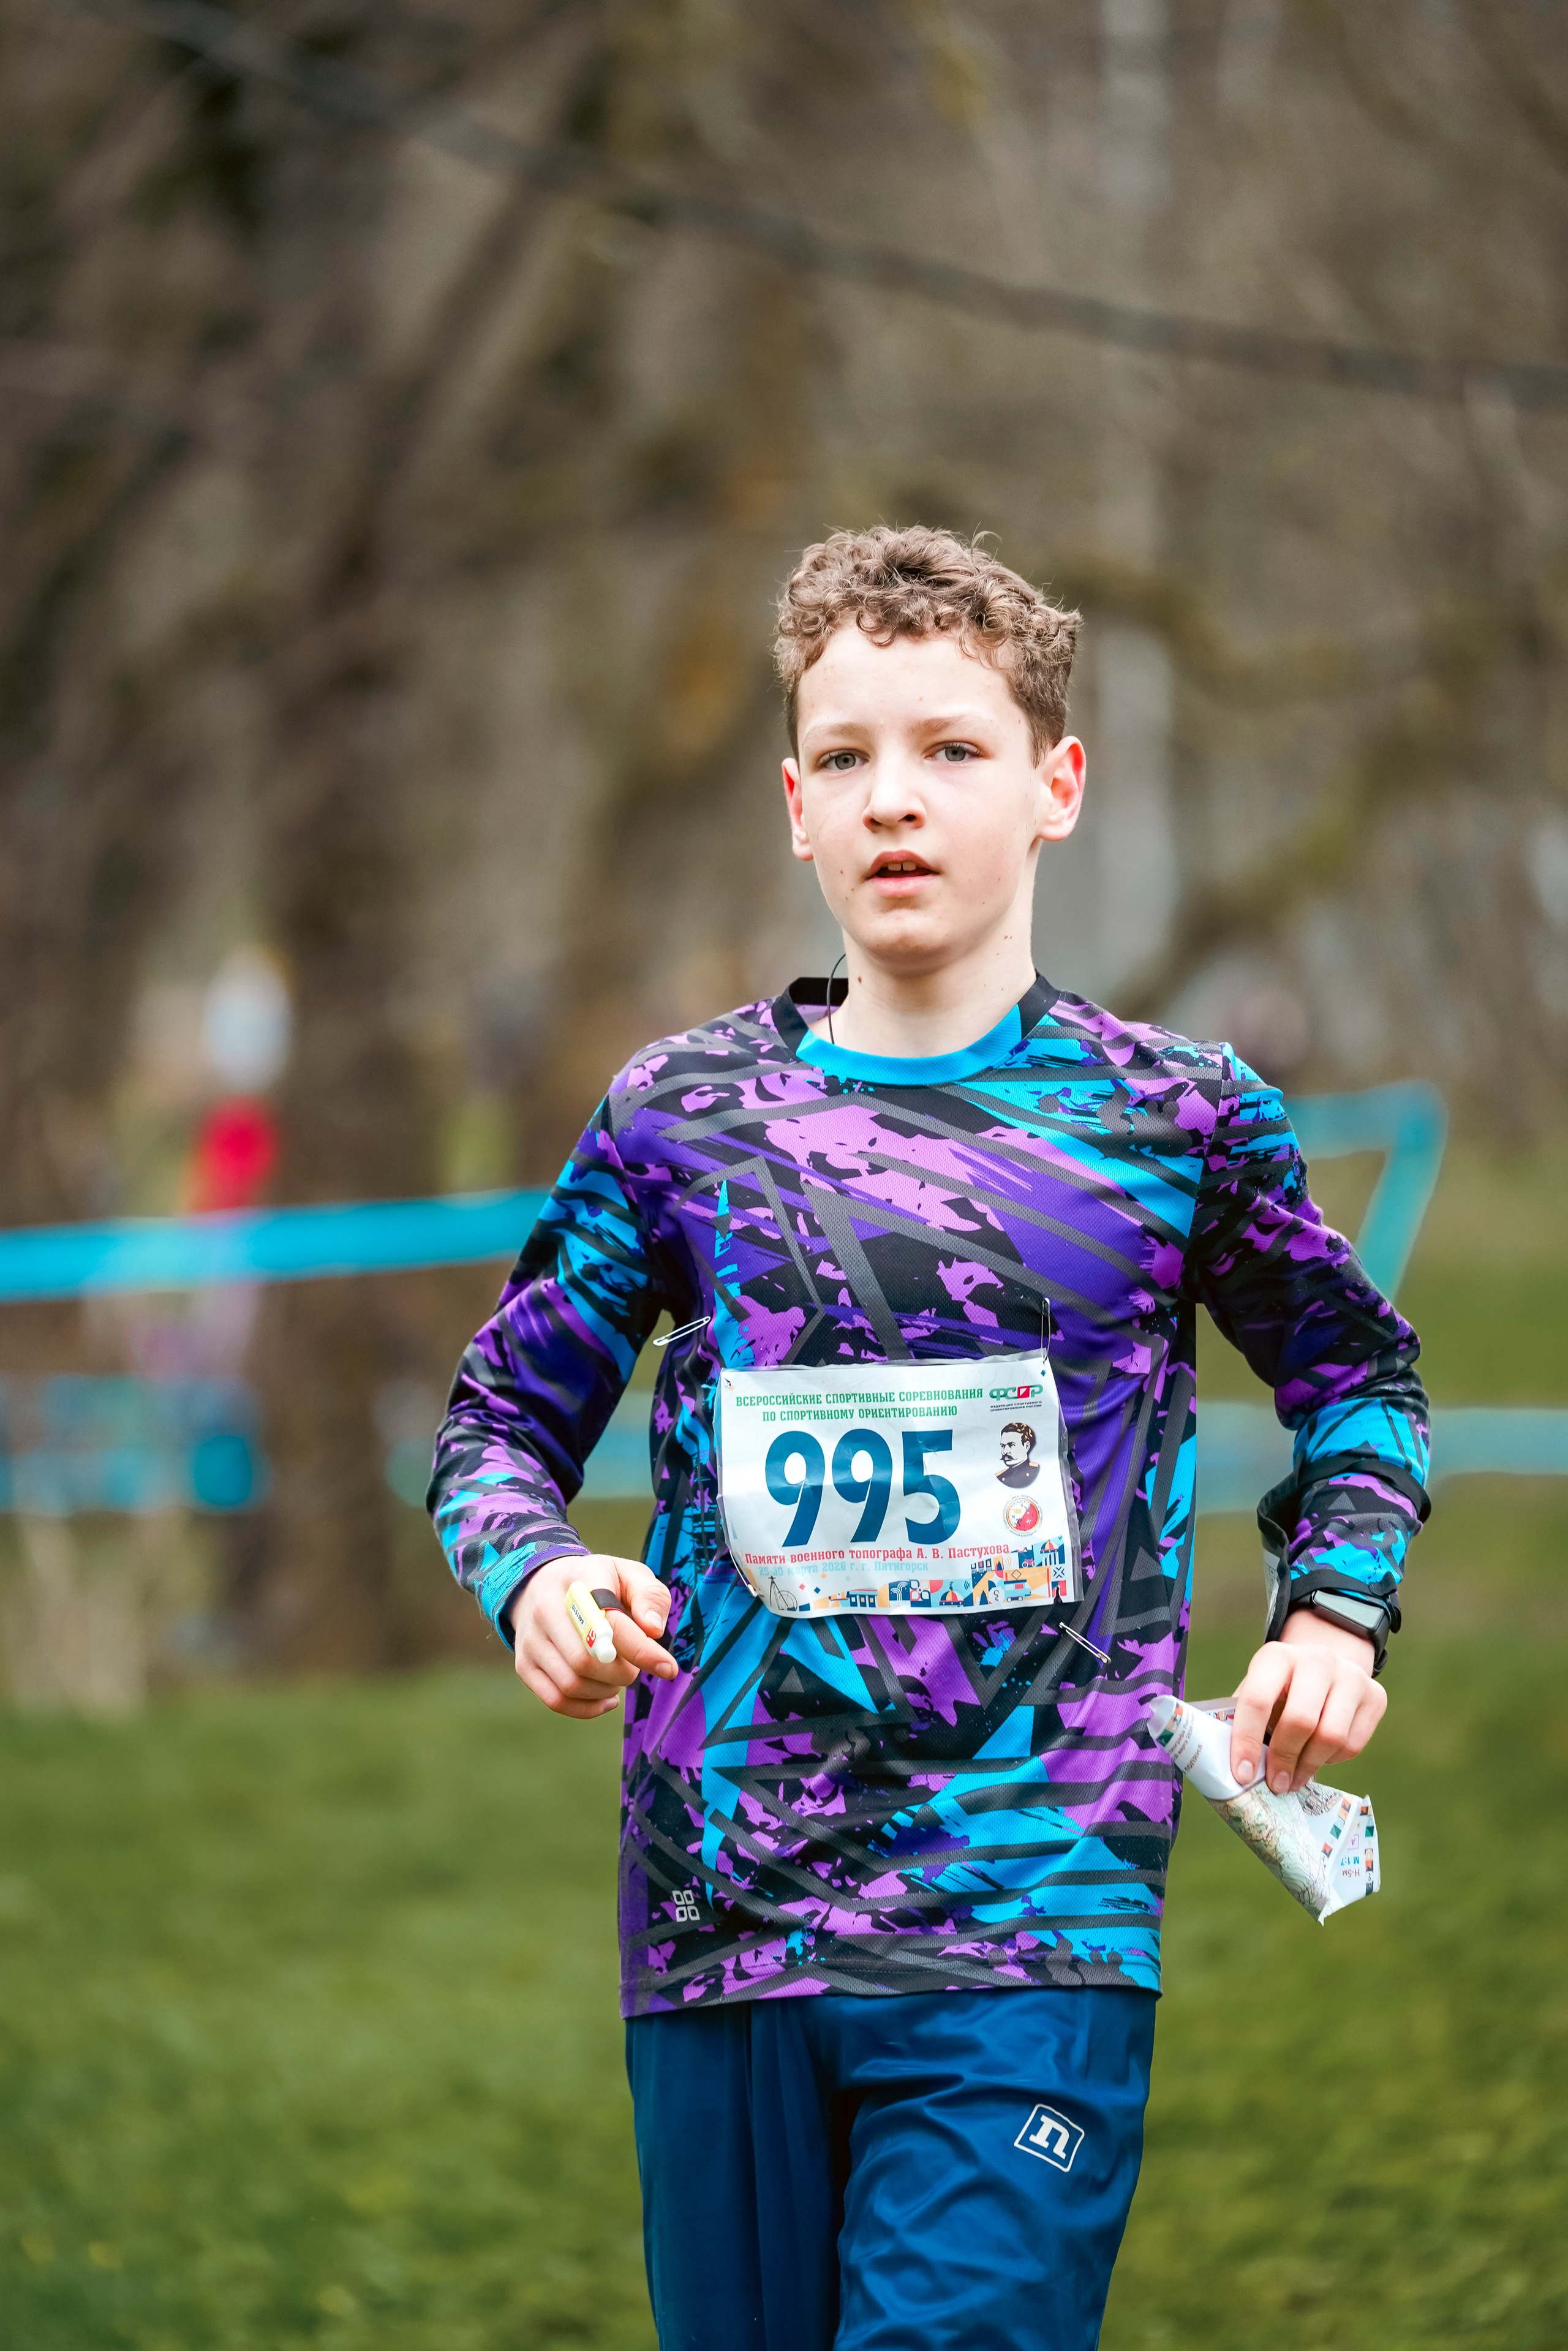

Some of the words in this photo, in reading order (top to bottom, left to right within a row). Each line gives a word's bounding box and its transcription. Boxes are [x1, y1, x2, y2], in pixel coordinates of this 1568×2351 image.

[736, 1392, 822, 1406] ВСЕРОССИЙСКИЕ
[826, 1392, 895, 1404] СПОРТИВНЫЕ
[899, 1388, 983, 1402] СОРЕВНОВАНИЯ
[763, 1411, 776, 1422] ПО
[780, 1409, 854, 1421] СПОРТИВНОМУ
[859, 1405, 957, 1419] ОРИЕНТИРОВАНИЮ
[765, 1428, 961, 1547] 995
[745, 1553, 786, 1564] Памяти
[790, 1550, 845, 1563] военного
[849, 1547, 912, 1561] топографа
[916, 1548, 927, 1559] А.
[932, 1548, 943, 1559] В.
[948, 1544, 1009, 1559] Пастухова
[787, 1563, 818, 1576] марта
[822, 1561, 846, 1572] 2026
[875, 1561, 929, 1573] Пятигорск
